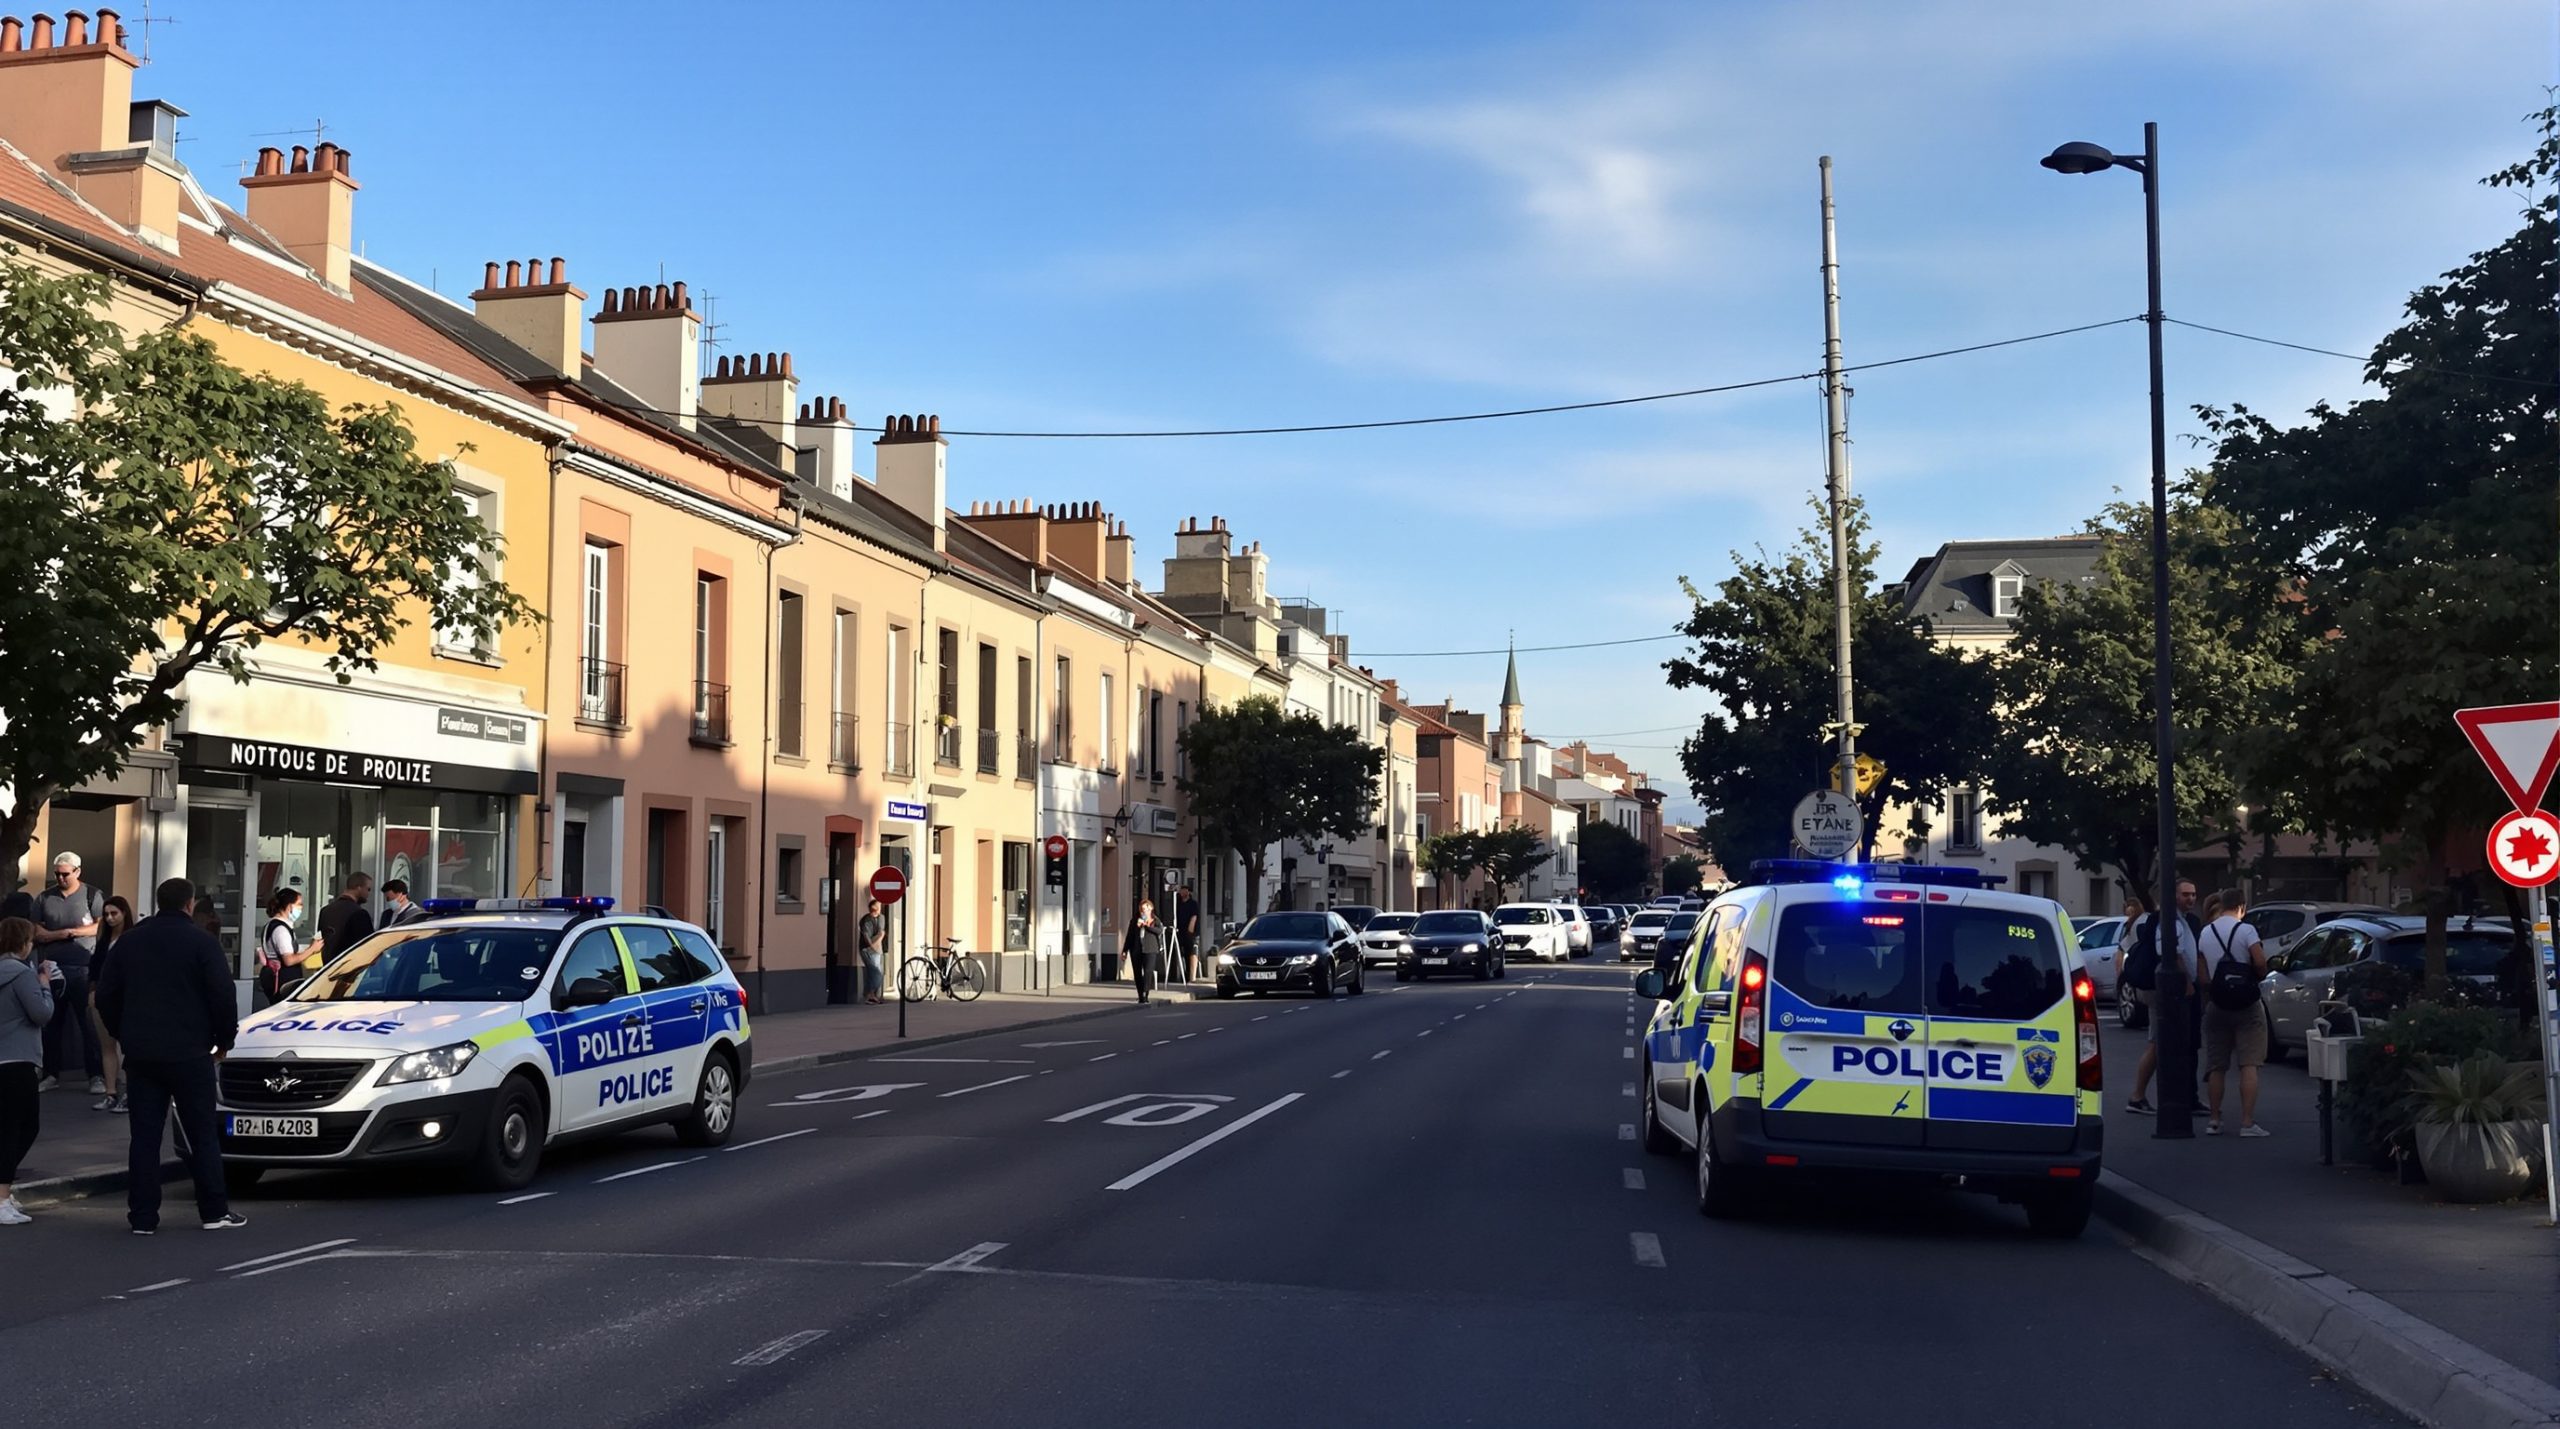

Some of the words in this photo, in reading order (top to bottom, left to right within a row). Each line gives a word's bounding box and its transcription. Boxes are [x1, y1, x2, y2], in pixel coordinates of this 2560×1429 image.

[231, 742, 316, 771] NOTTOUS
[325, 753, 348, 775] DE
[363, 758, 432, 783] PROLIZE
[577, 1024, 654, 1063] POLIZE
[1833, 1045, 2004, 1082] POLICE
[598, 1066, 674, 1108] POLICE
